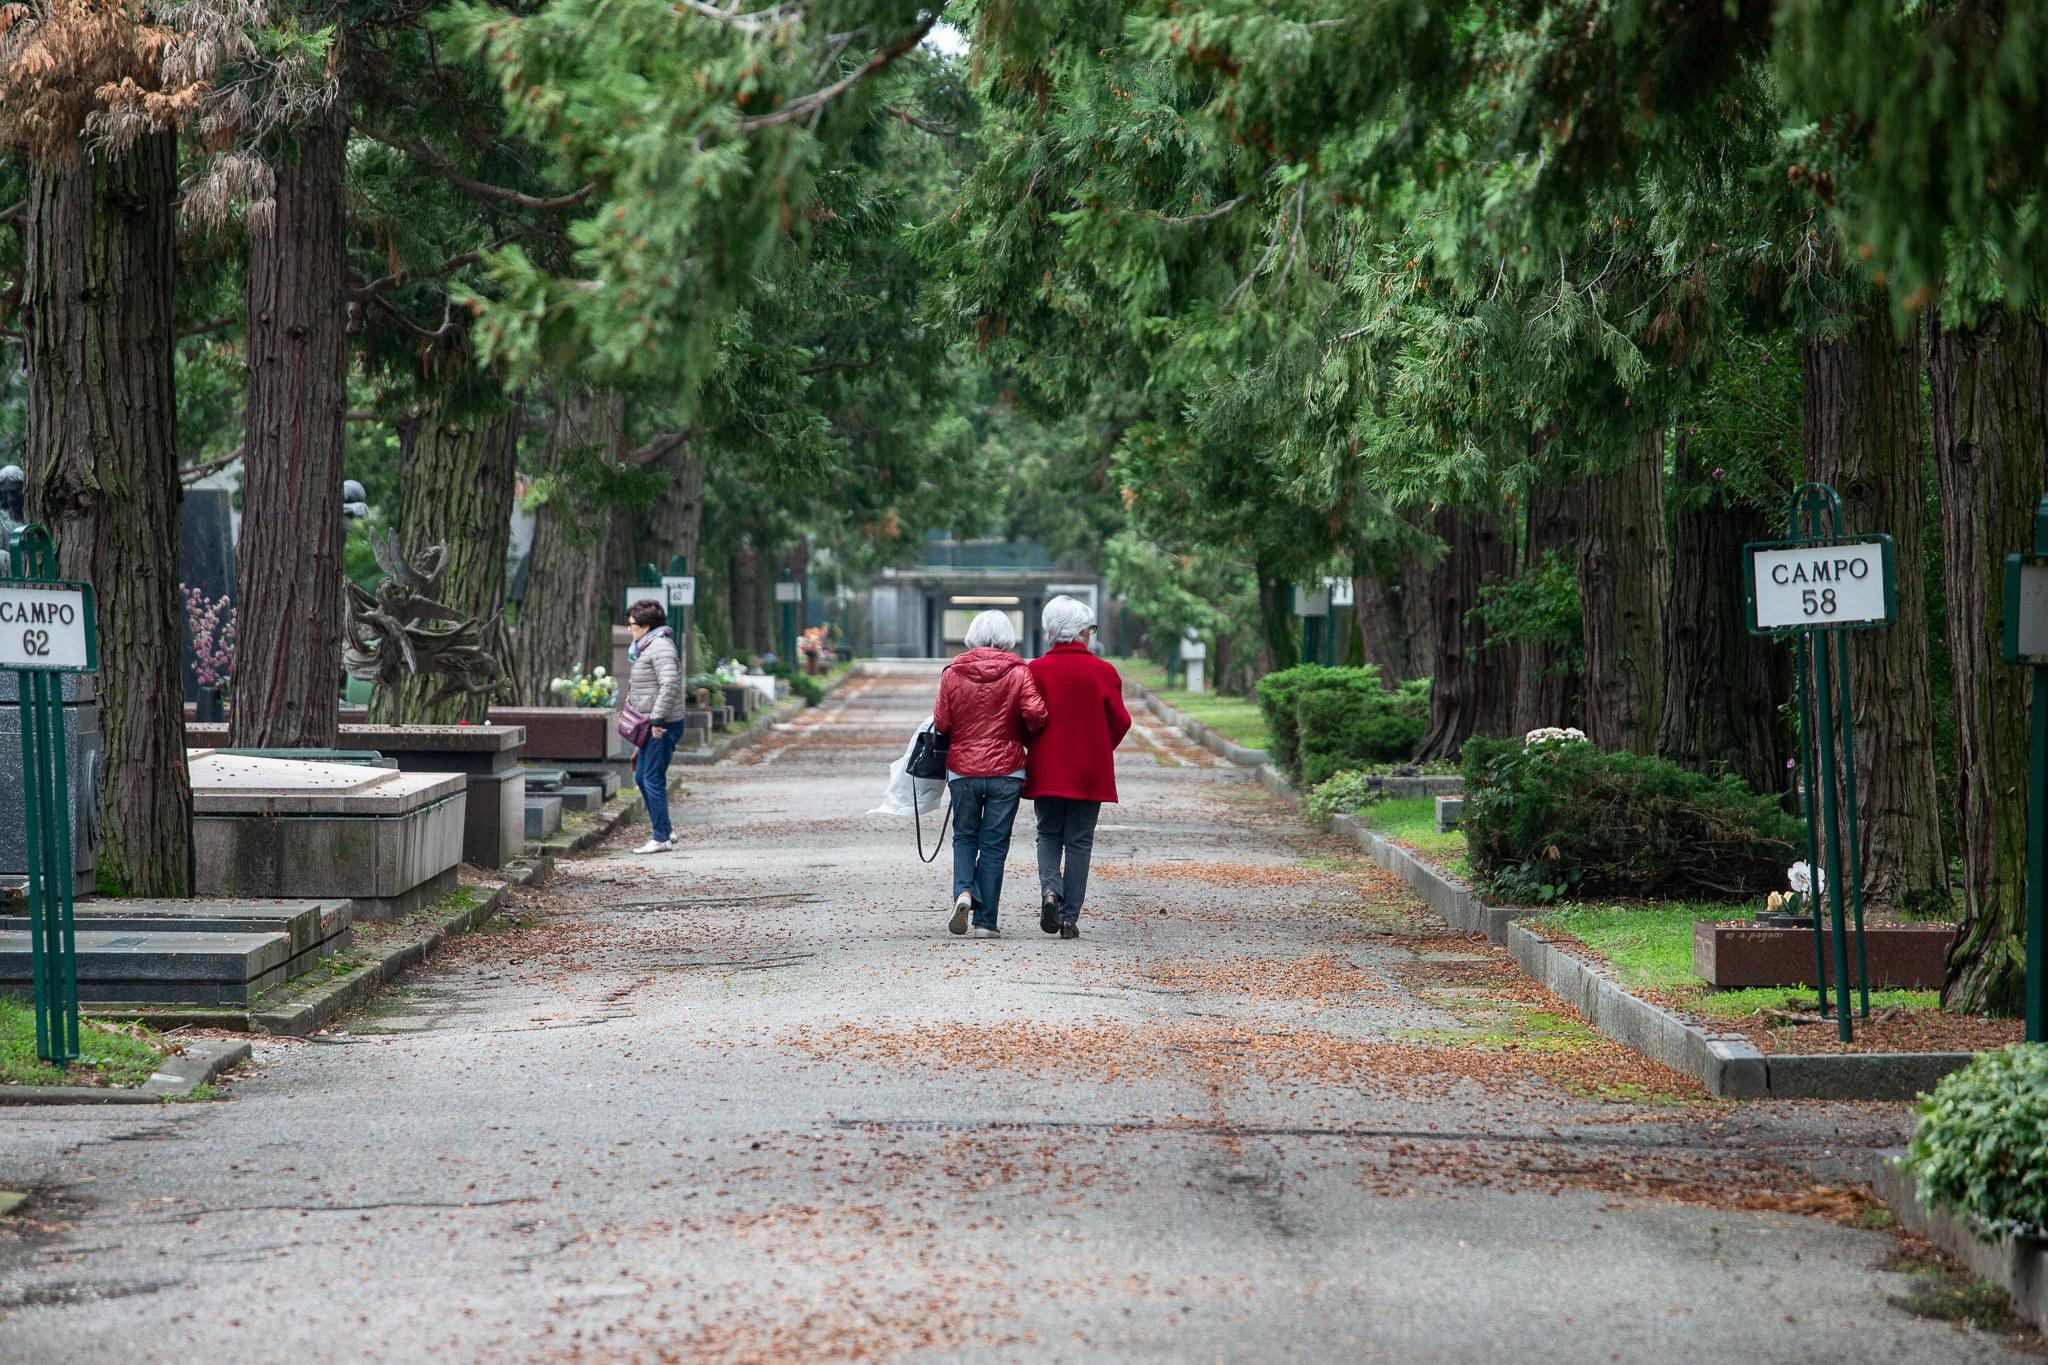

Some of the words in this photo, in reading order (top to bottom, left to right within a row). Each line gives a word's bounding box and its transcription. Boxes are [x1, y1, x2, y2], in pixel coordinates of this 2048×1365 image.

[1771, 557, 1869, 585] CAMPO
[0, 601, 75, 625] CAMPO
[1802, 588, 1837, 615] 58
[23, 628, 50, 656] 62
